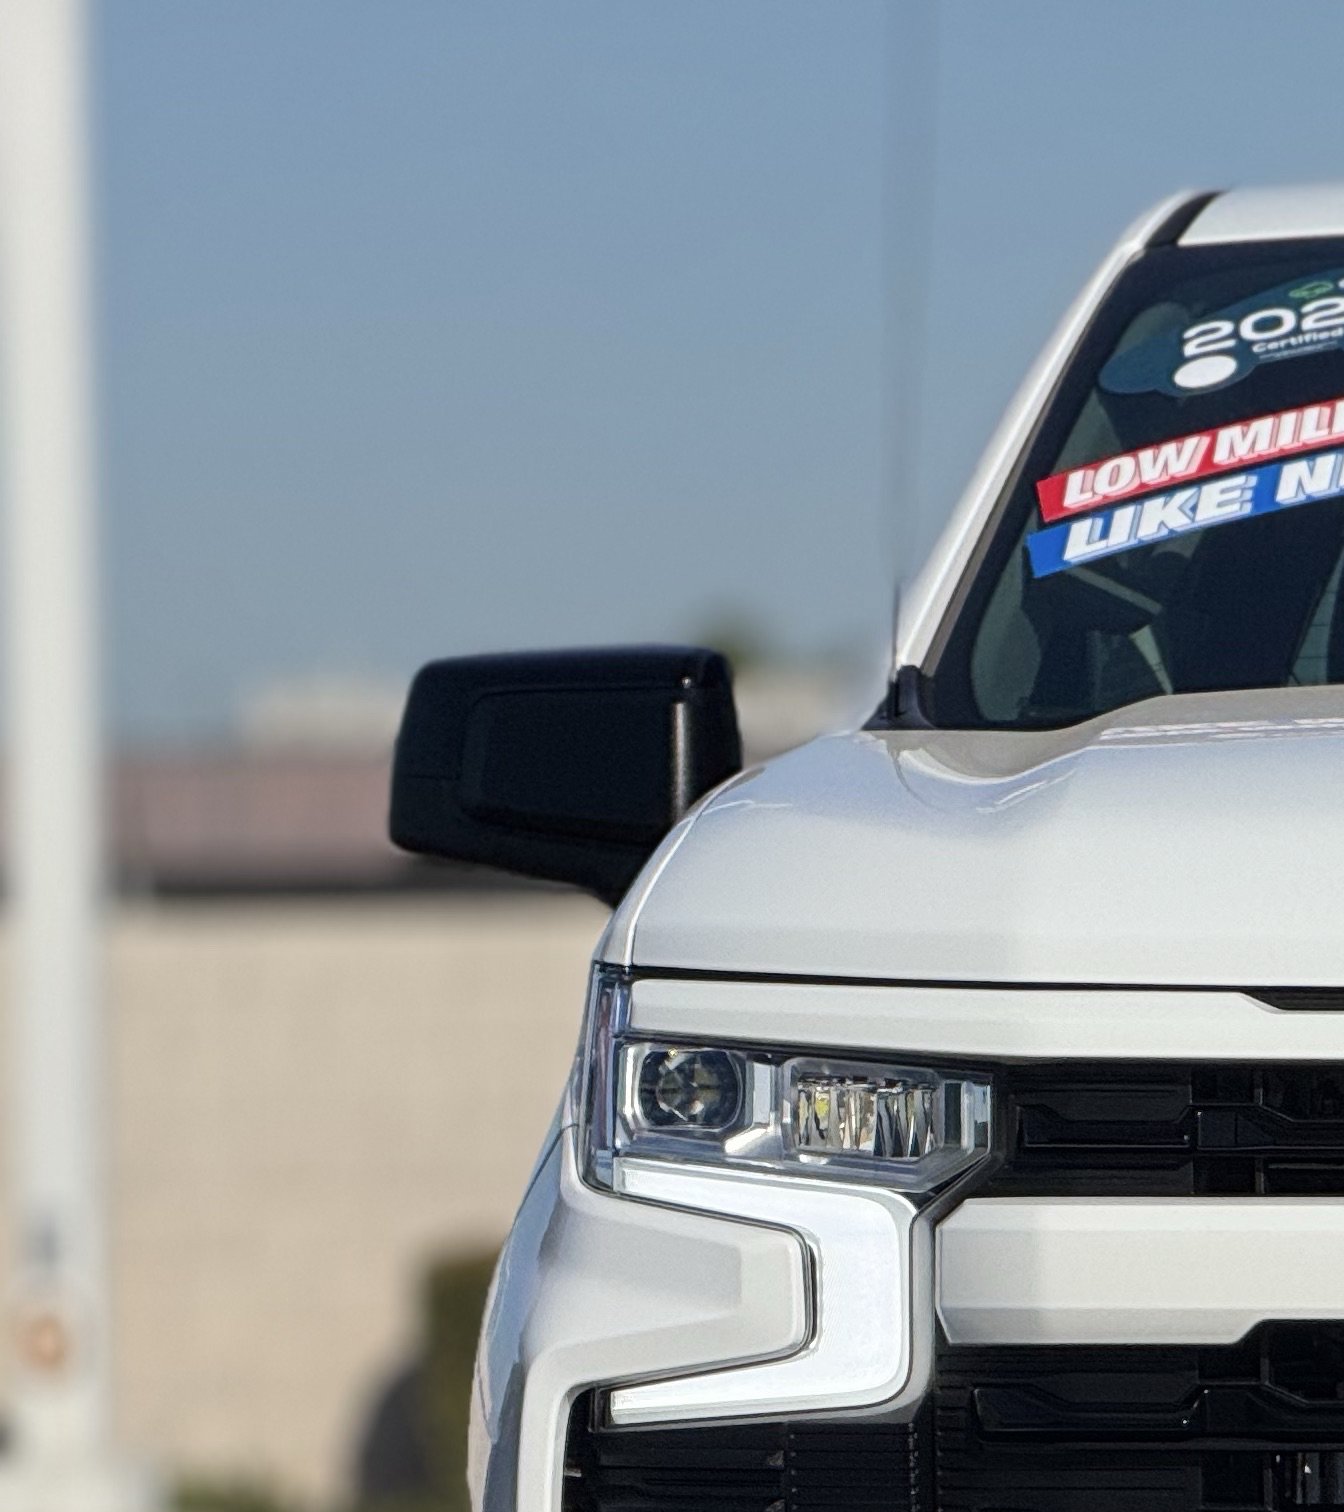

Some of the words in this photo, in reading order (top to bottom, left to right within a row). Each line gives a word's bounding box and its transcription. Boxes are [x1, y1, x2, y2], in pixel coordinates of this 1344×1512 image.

[1252, 327, 1344, 354] Certified
[1062, 435, 1211, 510] LOW
[1062, 474, 1258, 564] LIKE
